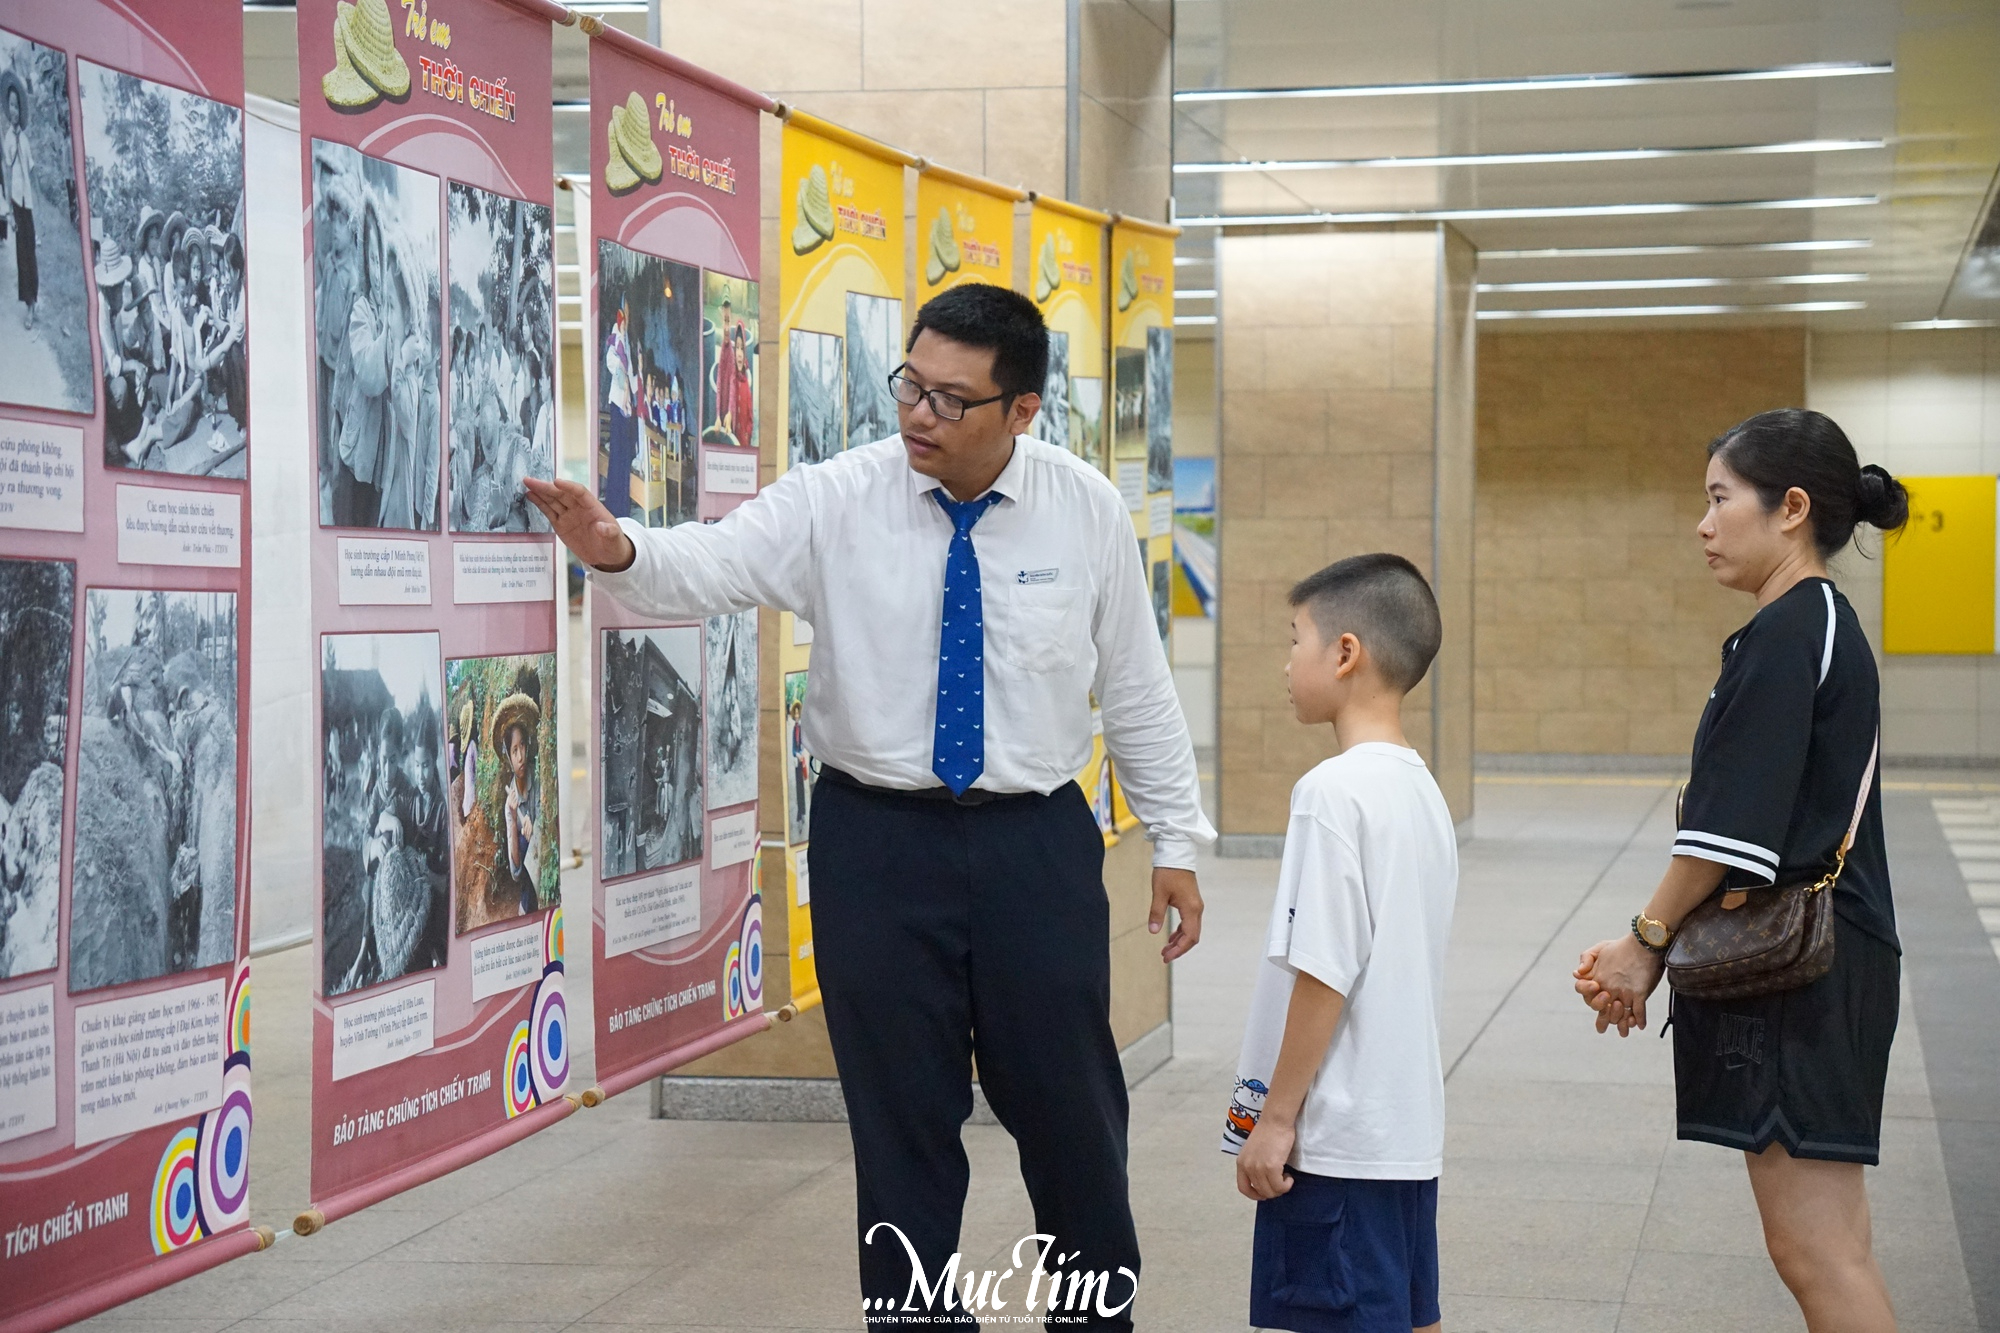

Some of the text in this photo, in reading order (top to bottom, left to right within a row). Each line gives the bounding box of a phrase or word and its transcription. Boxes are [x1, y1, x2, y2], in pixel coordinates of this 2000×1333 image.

[430, 19, 451, 50] em
[420, 56, 515, 122] THỜI CHIẾN
[669, 145, 736, 195] THỜI CHIẾN
[82, 1014, 101, 1034] Chuẩn
[104, 1017, 110, 1030] bị
[112, 1014, 126, 1026] khai
[128, 1011, 146, 1027] giảng
[148, 1007, 161, 1019] năm
[163, 1005, 173, 1018] học
[175, 1001, 185, 1014] mới
[609, 1008, 622, 1033] BẢO
[624, 1005, 642, 1027] TÀNG
[664, 992, 678, 1012] TÍCH
[679, 982, 697, 1007] CHIẾN
[697, 980, 716, 1000] TRANH
[81, 1040, 94, 1057] giáo
[96, 1034, 109, 1049] viên
[110, 1034, 117, 1046] và
[118, 1033, 129, 1045] học
[130, 1029, 144, 1043] sinh
[145, 1025, 165, 1039] trường
[166, 1020, 176, 1038] cấp
[81, 1059, 100, 1073] Thanh
[142, 1047, 151, 1059] đã
[81, 1079, 94, 1094] trăm
[109, 1069, 122, 1086] hầm
[135, 1065, 154, 1083] phòng
[97, 1095, 110, 1110] năm
[112, 1092, 123, 1106] học
[334, 1069, 491, 1146] BẢO TÀNG CHỨNG TÍCH CHIẾN TRANH
[5, 1192, 128, 1259] TÍCH CHIẾN TRANH
